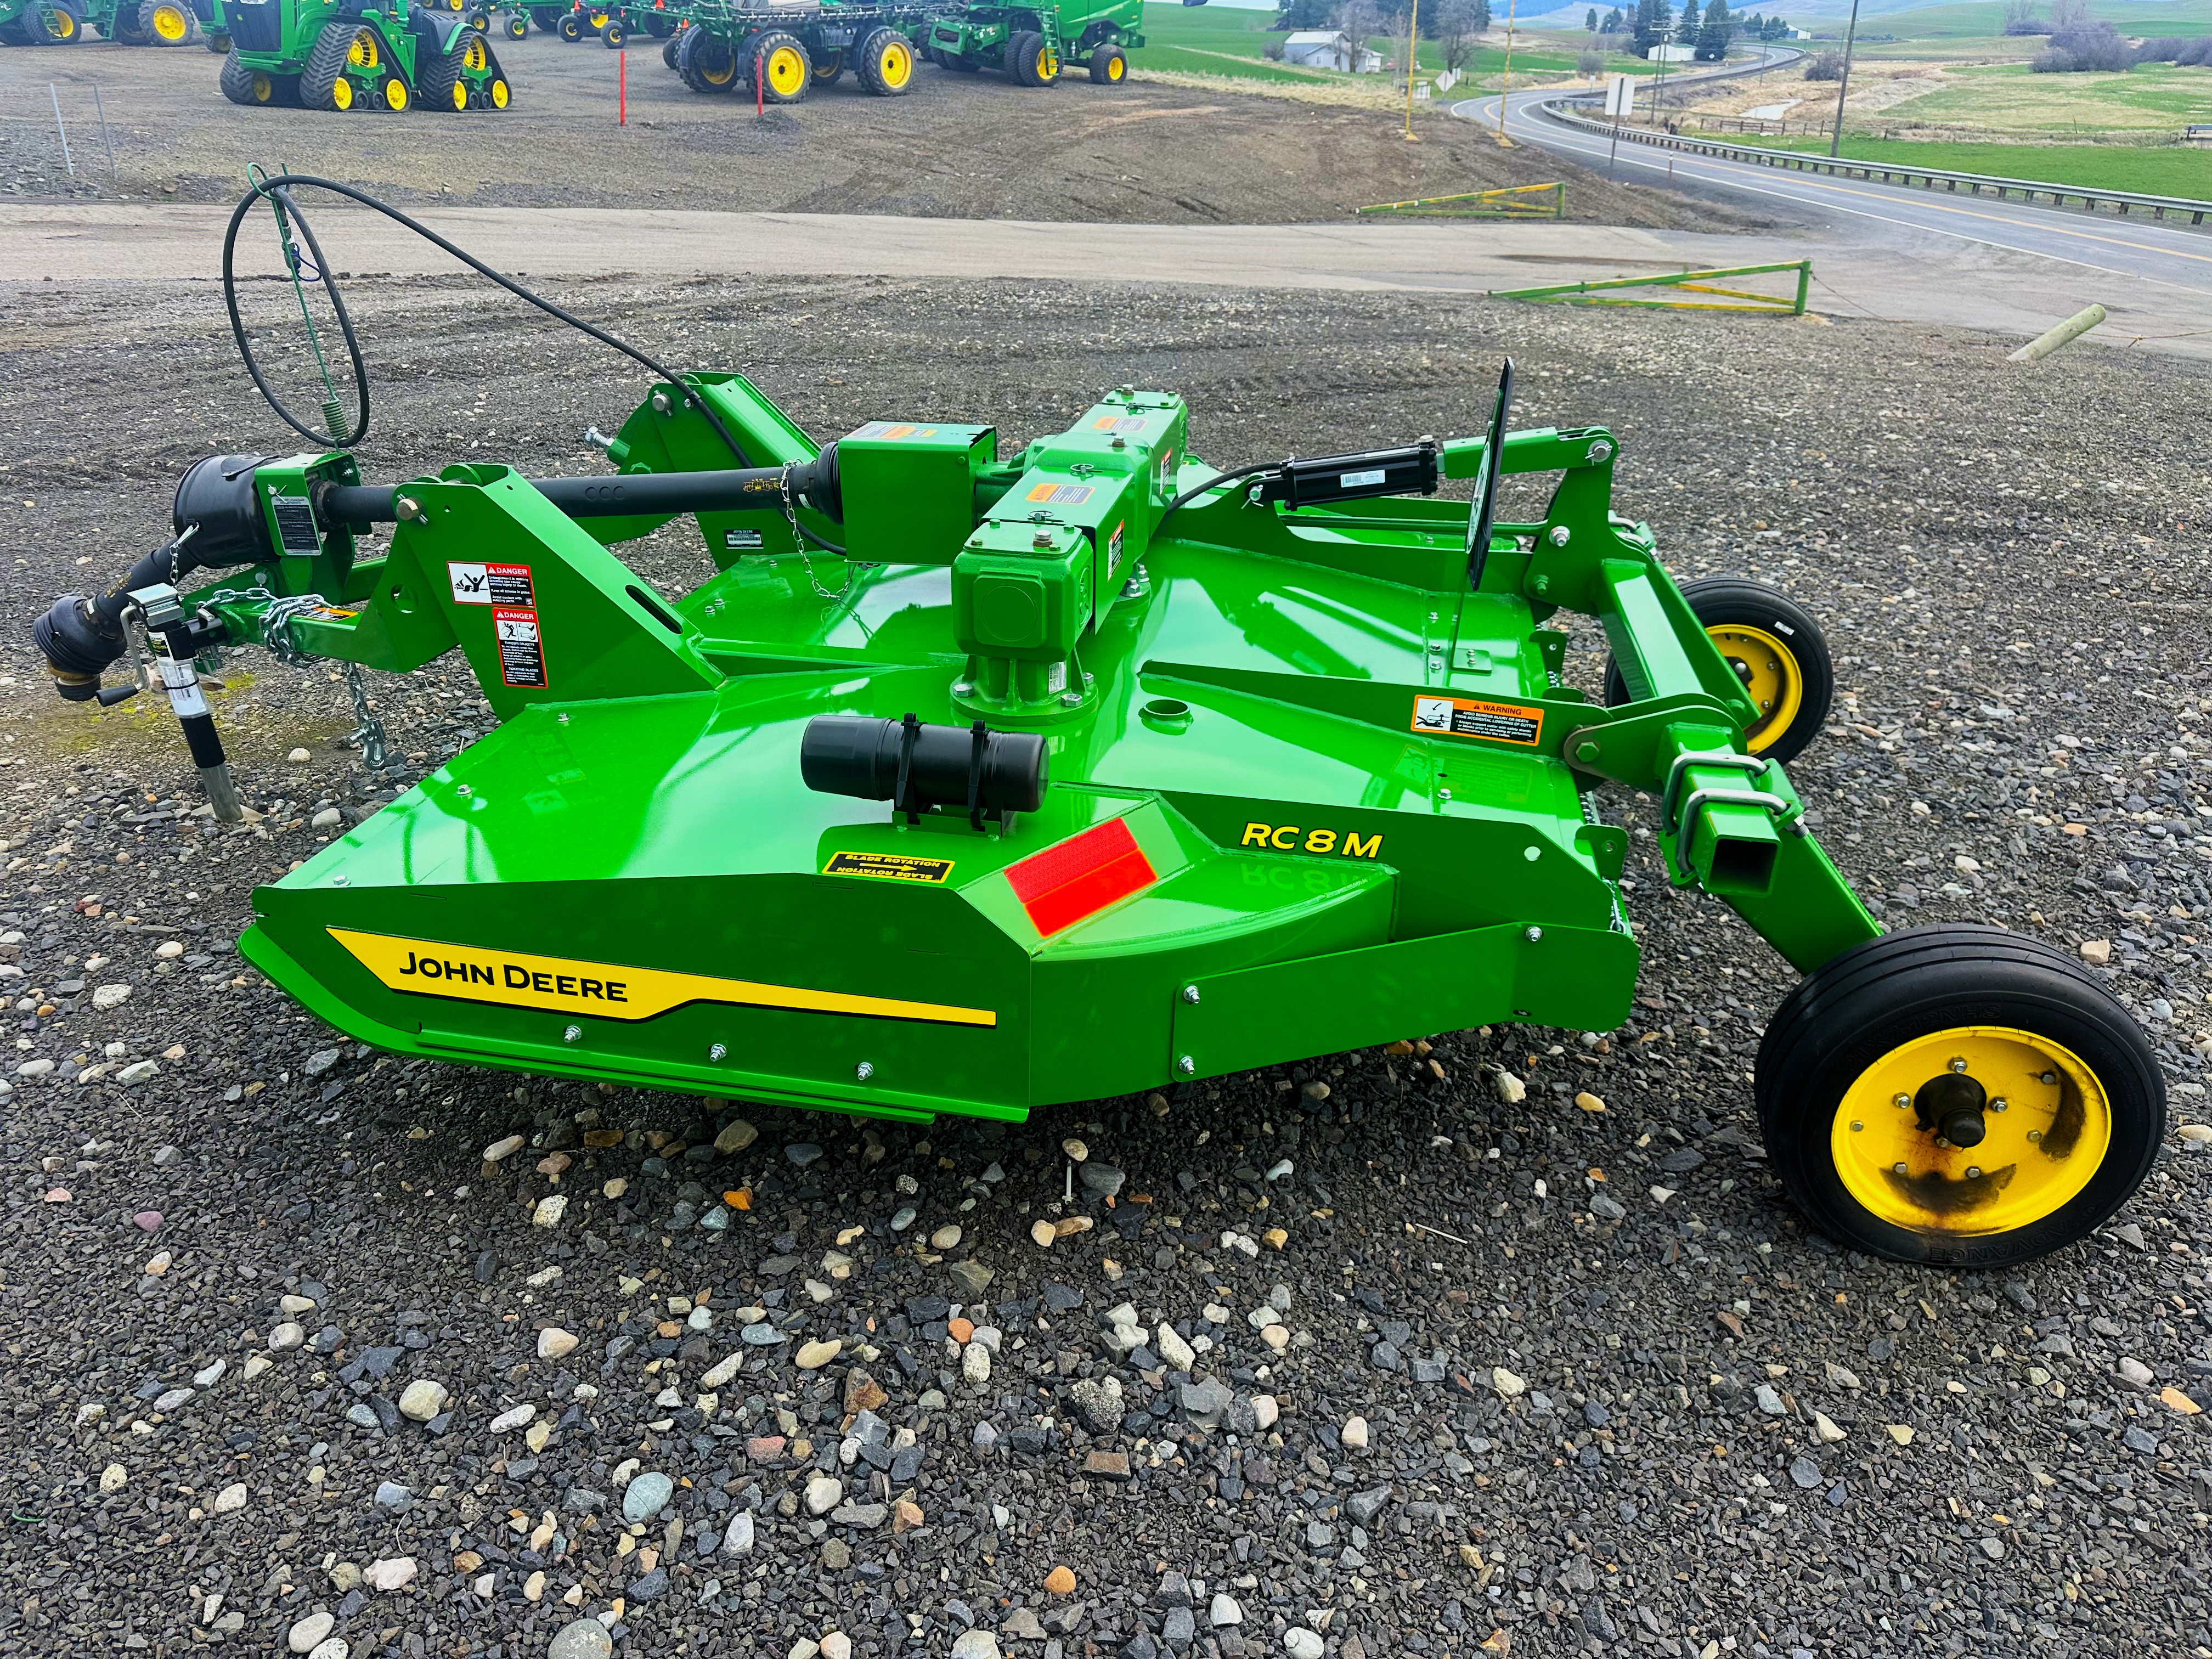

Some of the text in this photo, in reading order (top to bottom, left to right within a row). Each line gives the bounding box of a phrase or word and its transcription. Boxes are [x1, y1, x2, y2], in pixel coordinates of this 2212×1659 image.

[1483, 704, 1521, 715] WARNING
[884, 857, 940, 867] ROTATION
[836, 867, 894, 876] ROTATION
[399, 951, 628, 1003] JOHN DEERE
[1930, 1220, 2068, 1262] ADVANCE
